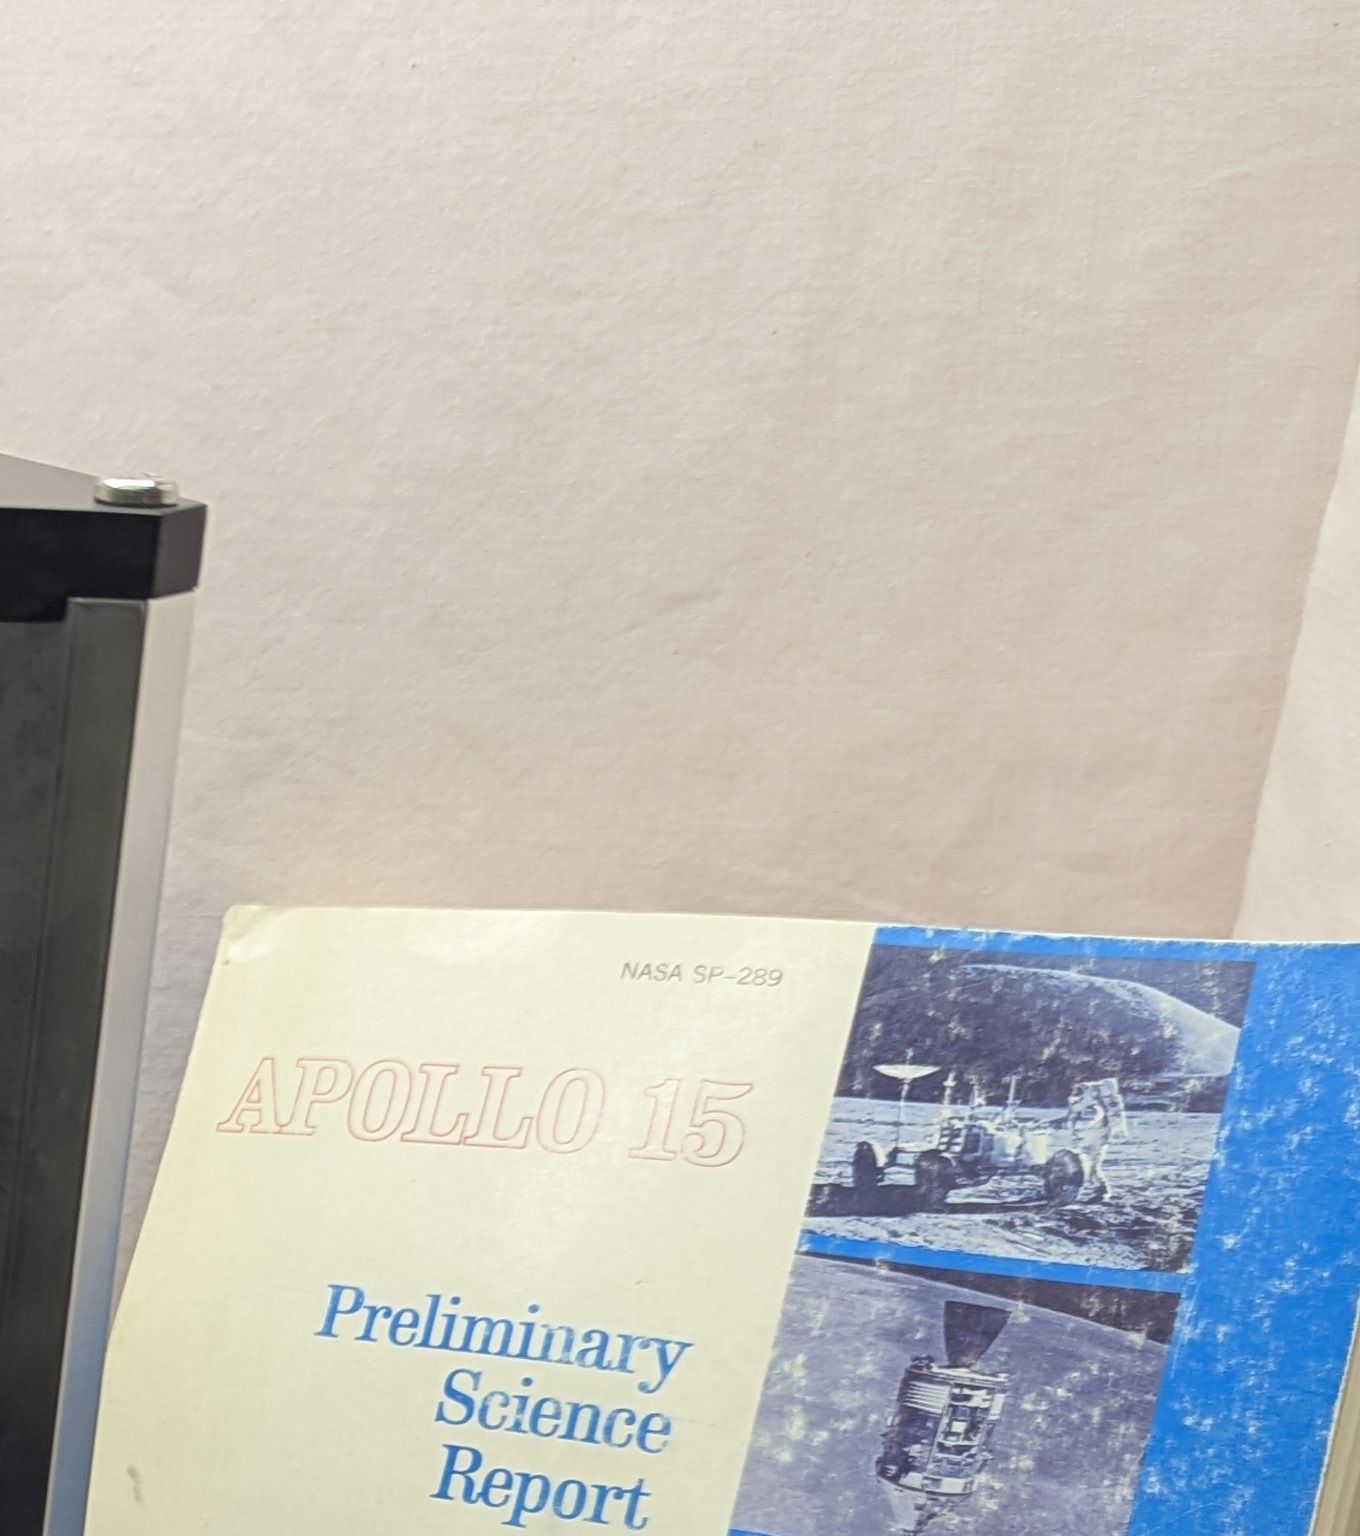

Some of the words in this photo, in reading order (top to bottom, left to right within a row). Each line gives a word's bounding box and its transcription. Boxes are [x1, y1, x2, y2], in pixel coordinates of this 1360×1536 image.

[620, 961, 683, 983] NASA
[692, 964, 784, 988] SP-289
[217, 1056, 605, 1154] APOLLO
[628, 1079, 754, 1167] 15
[313, 1283, 694, 1394] Preliminary
[434, 1368, 673, 1454] Science
[429, 1444, 652, 1531] Report
